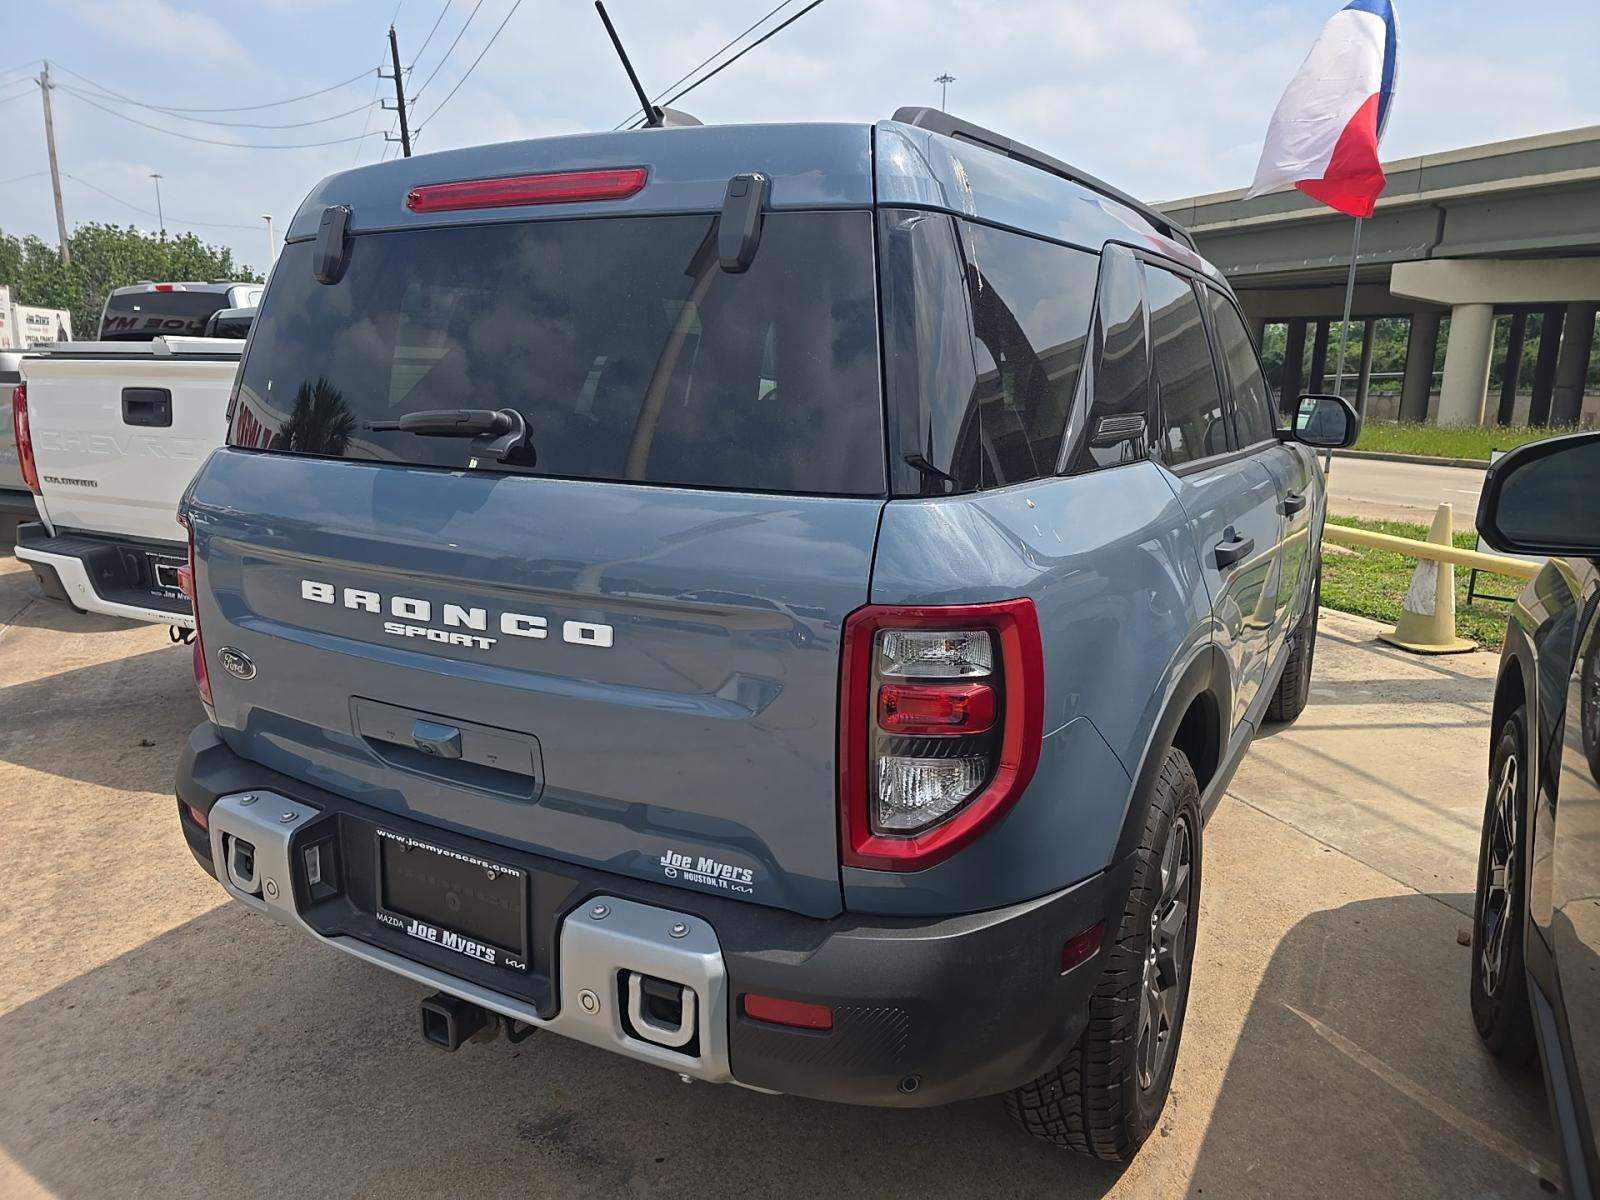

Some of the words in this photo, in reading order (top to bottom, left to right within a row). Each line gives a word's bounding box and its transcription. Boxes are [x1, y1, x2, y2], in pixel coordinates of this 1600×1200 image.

[43, 476, 98, 488] COLORADO
[301, 579, 614, 648] BRONCO
[383, 621, 498, 650] SPORT
[376, 828, 521, 877] www.joemyerscars.com
[660, 849, 692, 869] Joe
[696, 856, 754, 883] Myers
[376, 912, 404, 929] MAZDA
[407, 919, 438, 942] Joe
[442, 929, 496, 964] Myers
